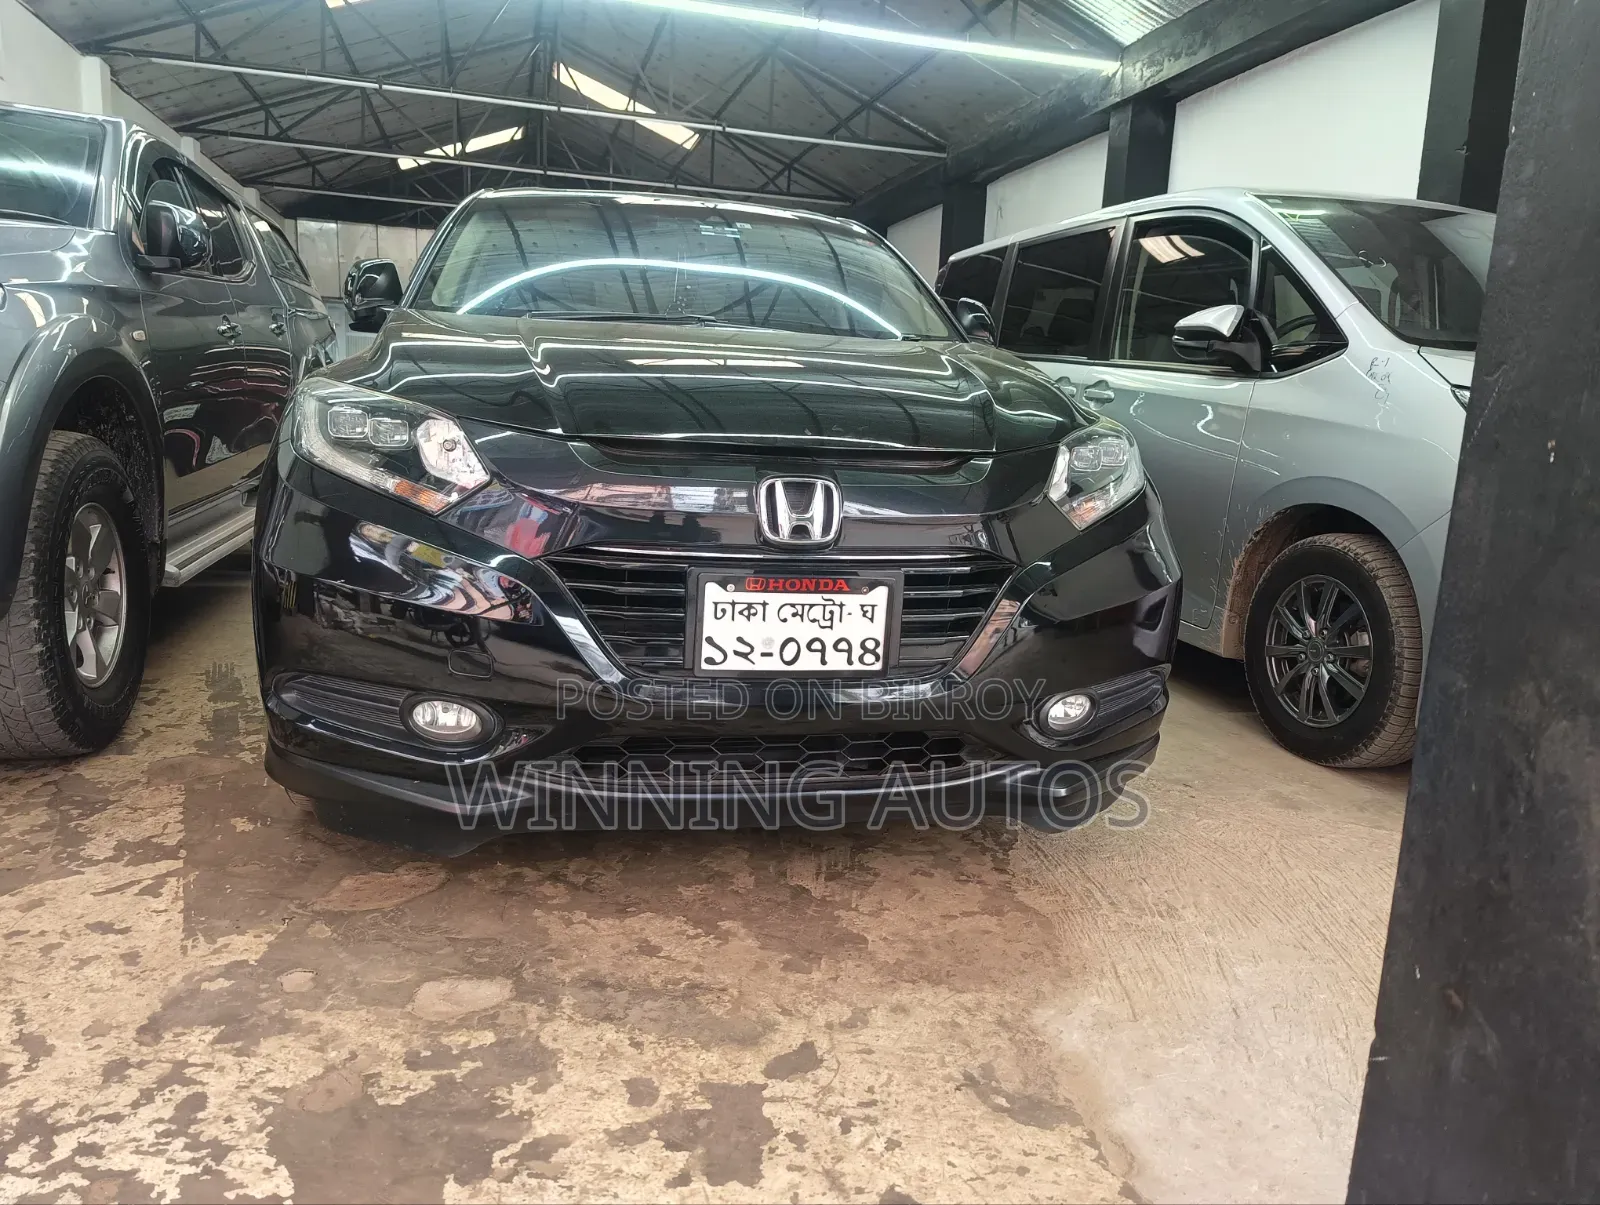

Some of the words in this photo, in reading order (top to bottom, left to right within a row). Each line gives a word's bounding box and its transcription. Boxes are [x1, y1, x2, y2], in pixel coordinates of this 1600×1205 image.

[767, 578, 850, 591] HONDA
[712, 599, 769, 622] ঢাকা
[704, 635, 881, 667] ১২-০৭৭৪
